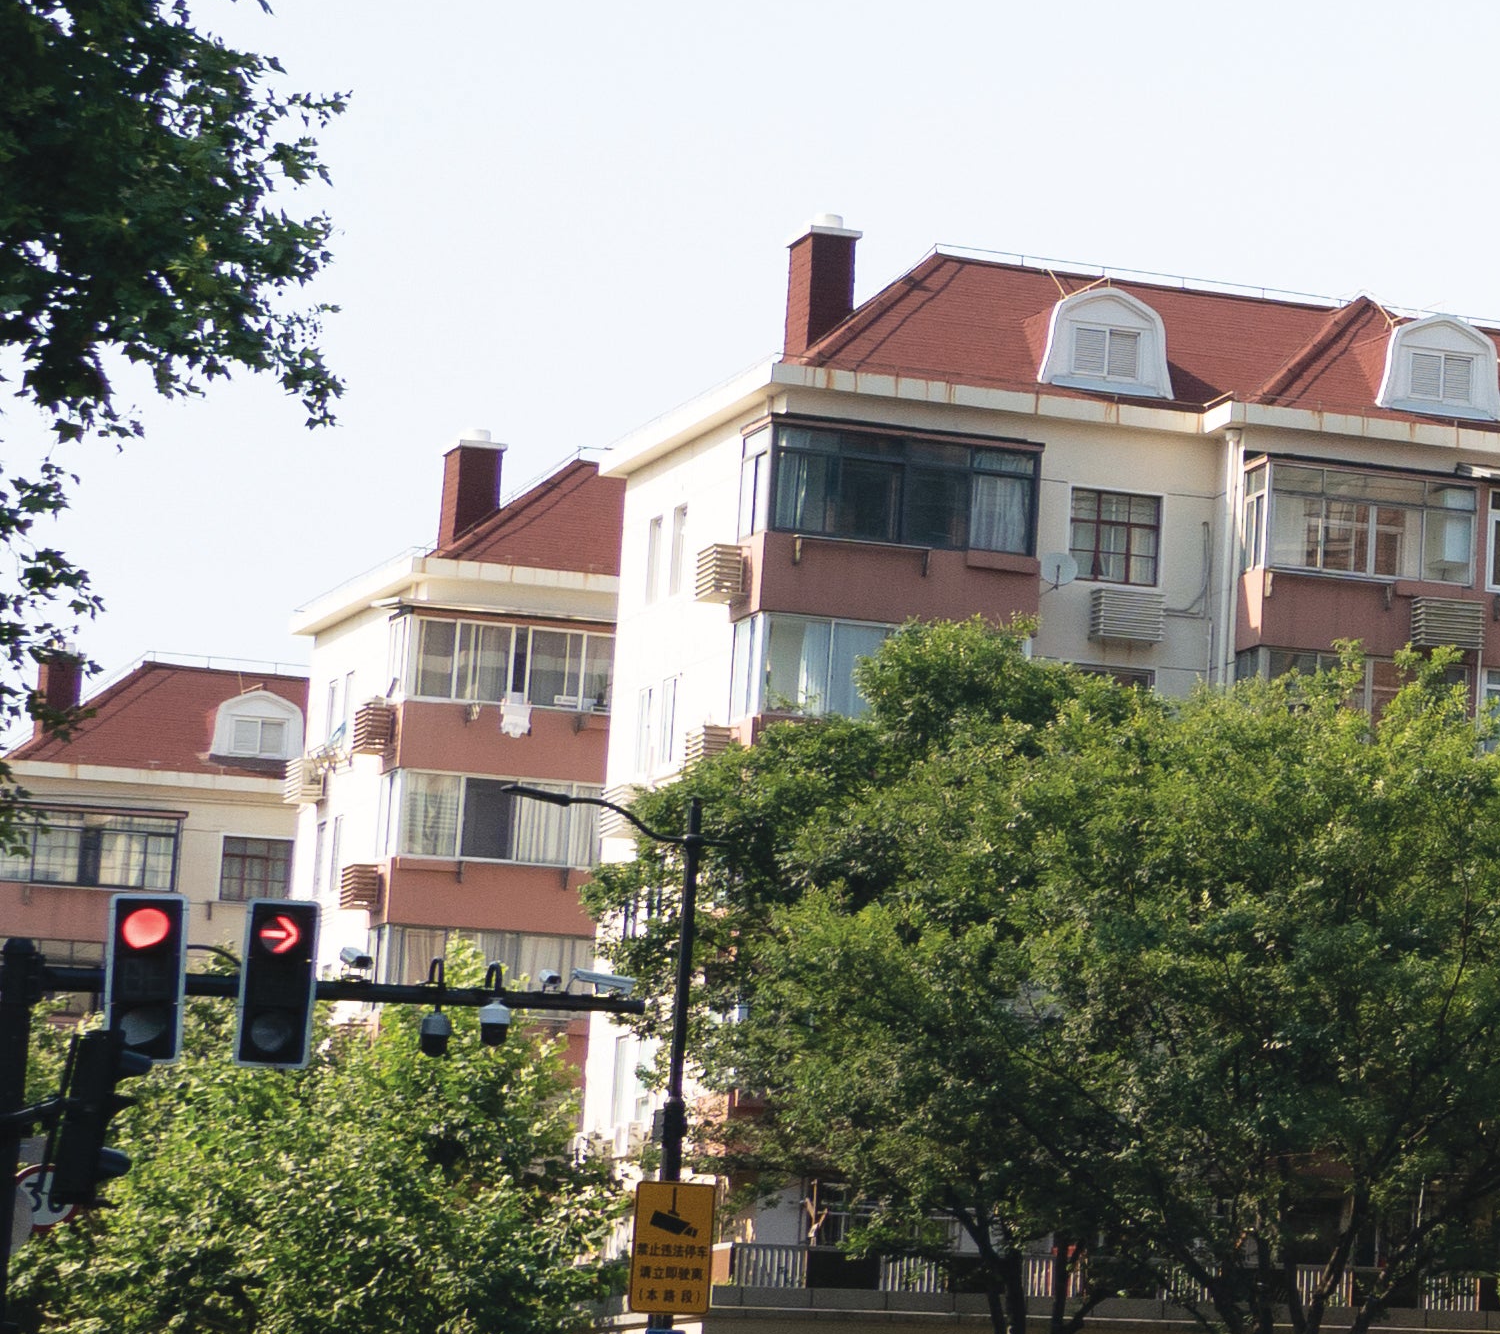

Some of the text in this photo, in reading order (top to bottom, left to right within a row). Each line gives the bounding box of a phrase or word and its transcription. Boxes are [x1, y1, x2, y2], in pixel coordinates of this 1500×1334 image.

[637, 1243, 708, 1259] 禁止违法停车
[640, 1266, 703, 1281] 请立即驶离
